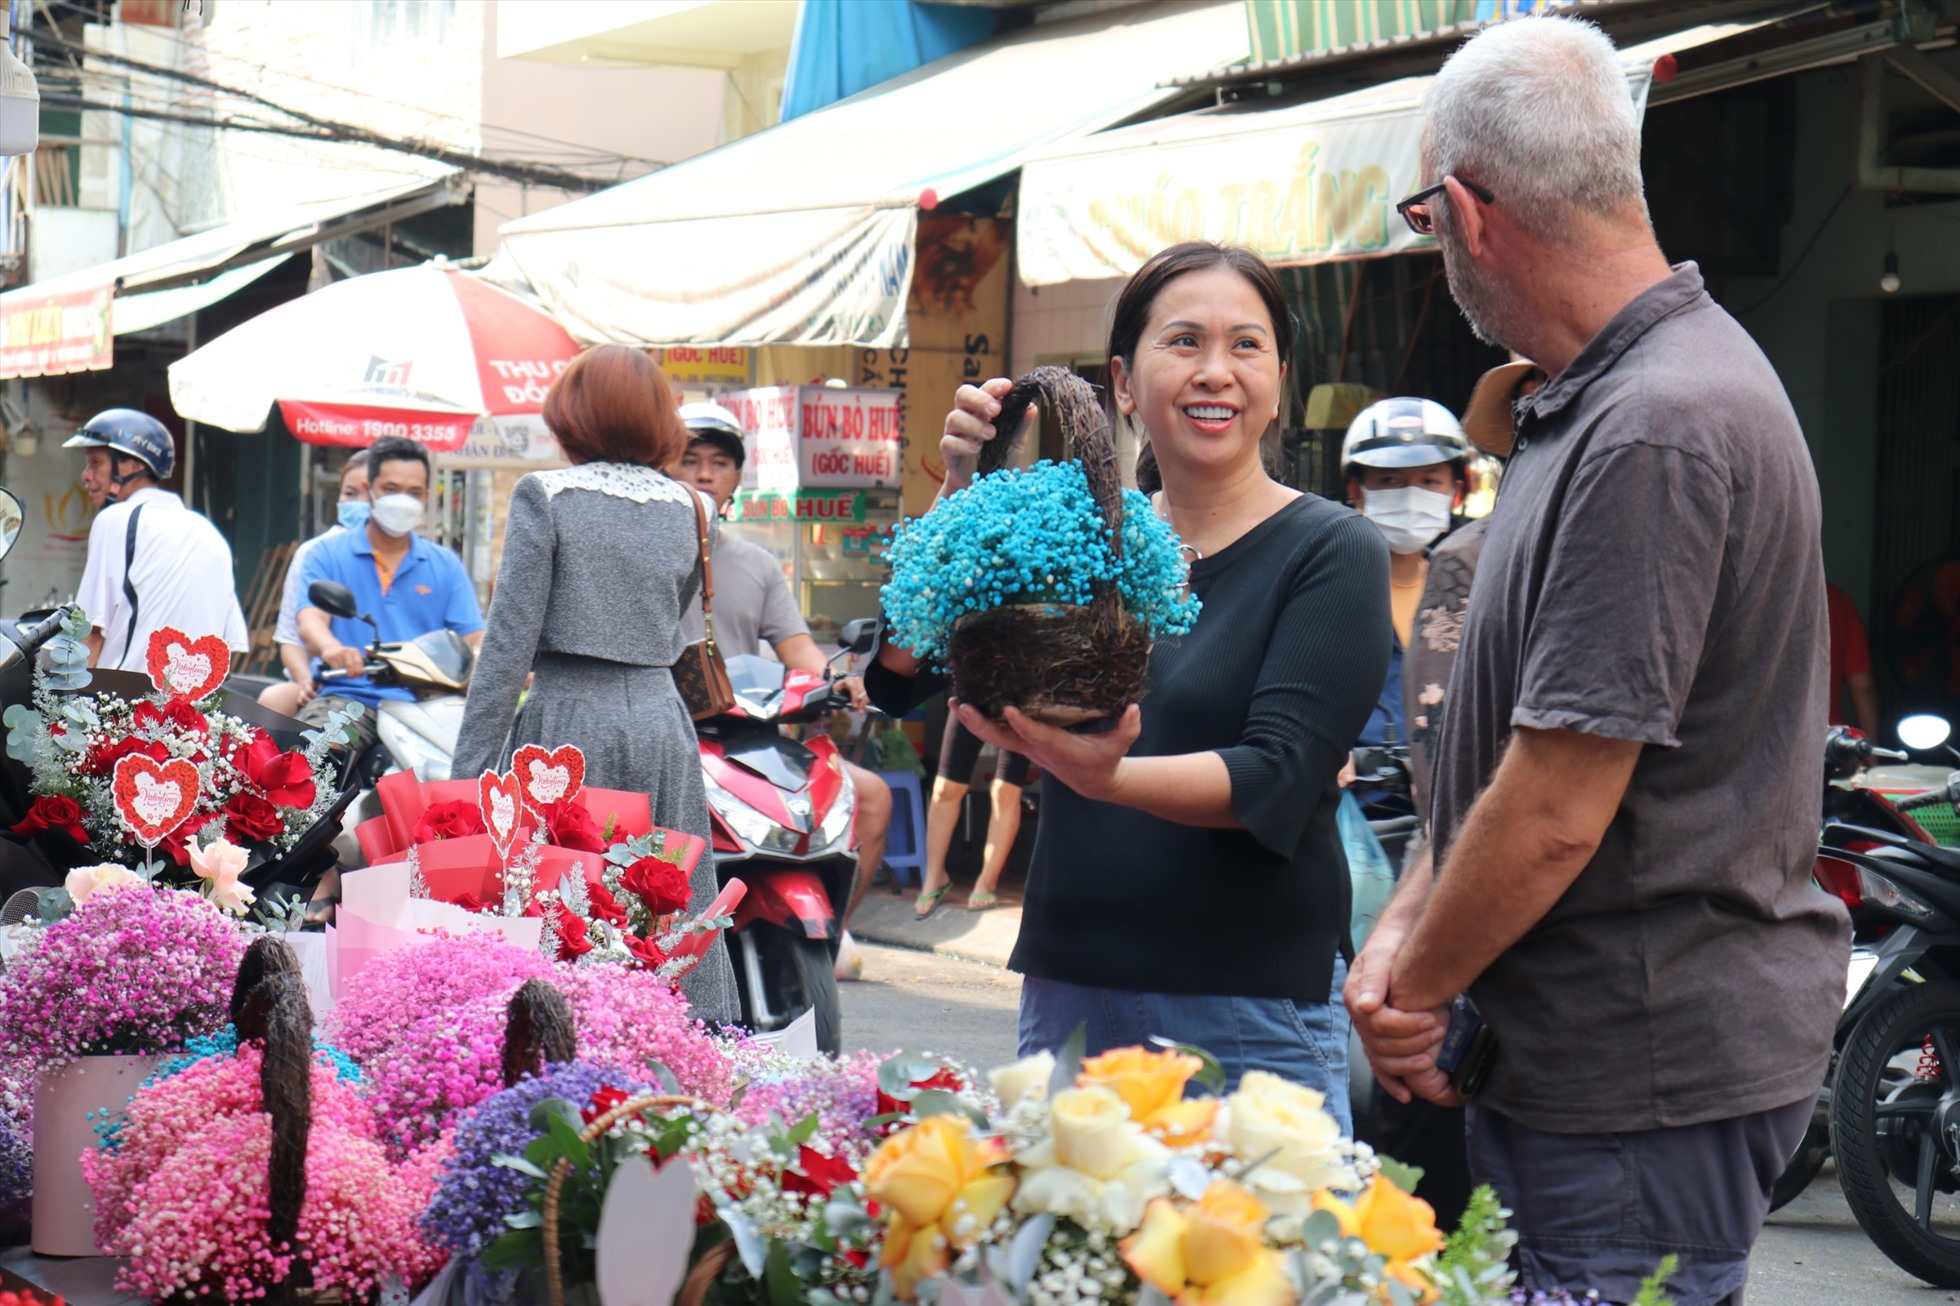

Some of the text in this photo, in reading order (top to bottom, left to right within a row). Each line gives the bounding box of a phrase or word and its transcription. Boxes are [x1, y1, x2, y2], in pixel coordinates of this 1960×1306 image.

[1219, 141, 1392, 257] TRẮNG
[489, 360, 550, 378] THU
[296, 418, 358, 436] Hotline:
[361, 420, 406, 438] 1900
[410, 424, 456, 441] 3355
[802, 394, 901, 441] BÚN BÒ HUẾ
[812, 447, 891, 476] (GỐC HUẾ)
[796, 491, 858, 519] HUẾ
